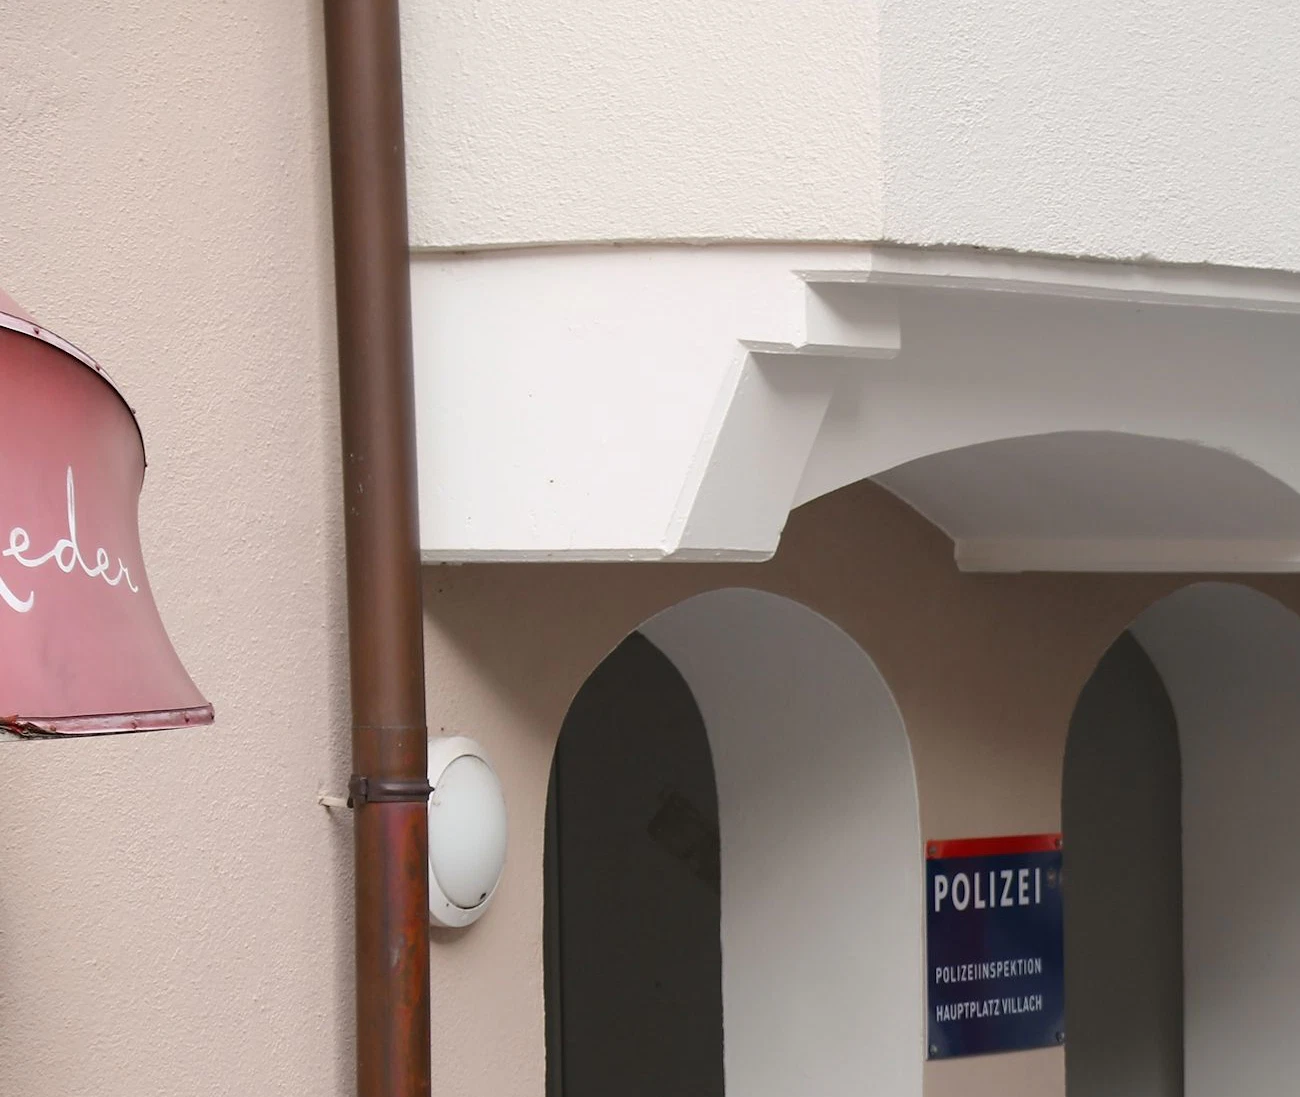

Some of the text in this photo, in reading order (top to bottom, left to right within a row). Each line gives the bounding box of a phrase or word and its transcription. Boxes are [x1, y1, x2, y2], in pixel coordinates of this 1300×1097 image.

[0, 466, 139, 613] eder
[934, 867, 1042, 912] POLIZEI
[935, 957, 1042, 984] POLIZEIINSPEKTION
[936, 995, 1042, 1022] HAUPTPLATZ VILLACH
